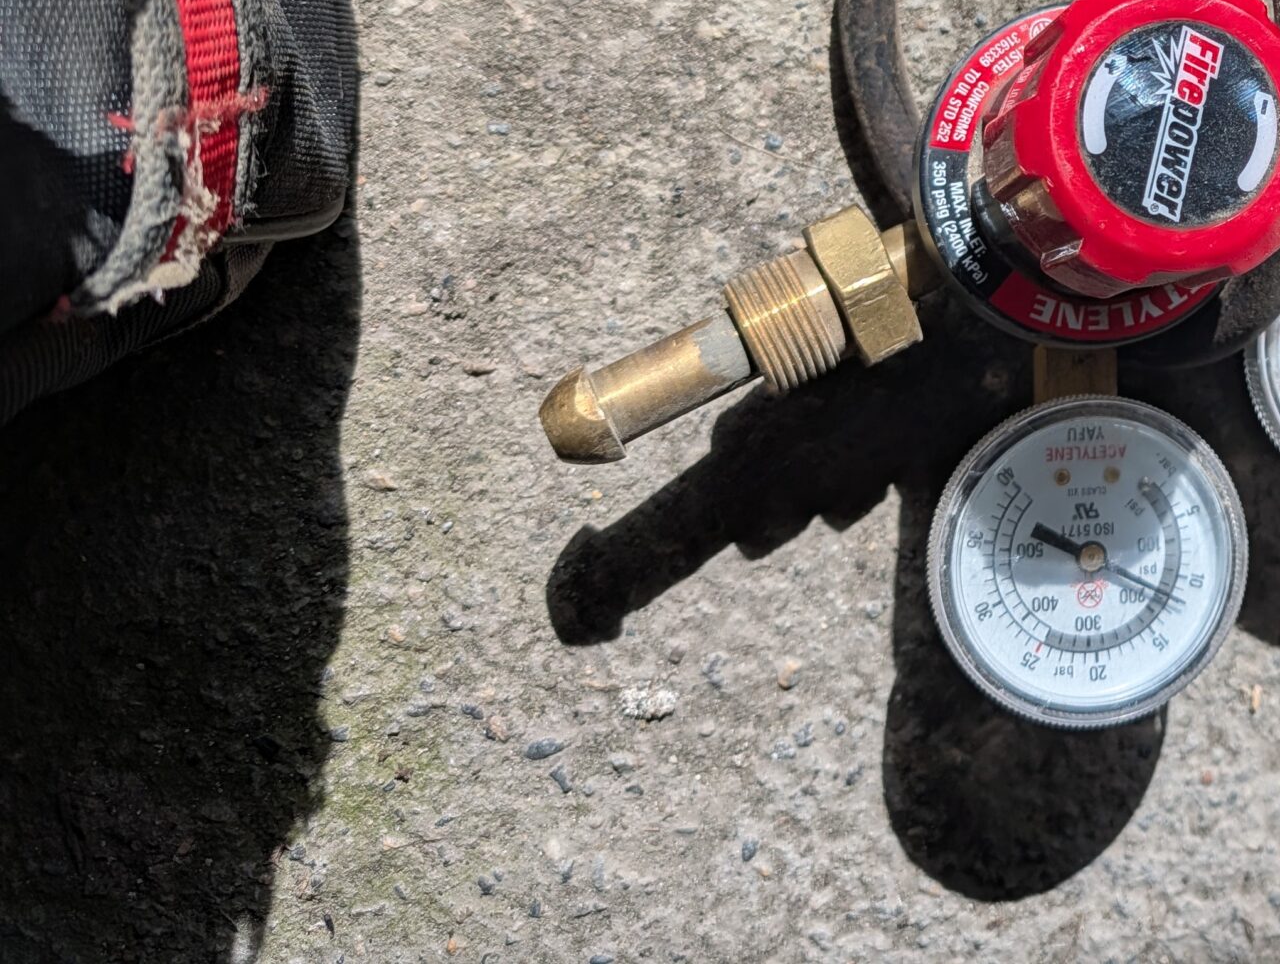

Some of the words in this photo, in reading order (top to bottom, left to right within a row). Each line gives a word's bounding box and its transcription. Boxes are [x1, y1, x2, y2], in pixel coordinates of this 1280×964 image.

[977, 31, 1021, 68] 3163339
[962, 68, 981, 85] TO
[953, 81, 971, 99] UL
[942, 96, 961, 121] STD
[953, 80, 990, 142] CONFORMS
[933, 121, 952, 143] 252
[1152, 33, 1221, 217] Firepower
[932, 161, 946, 186] 350
[931, 189, 949, 218] psig
[949, 181, 967, 217] MAX.
[958, 217, 985, 257] INLET:
[940, 220, 968, 257] (2400
[961, 255, 988, 285] kPa)
[1028, 282, 1200, 331] TYLENE
[1066, 426, 1105, 441] YAFU
[1045, 445, 1127, 462] ACETYLENE
[996, 467, 1016, 487] 40
[1126, 498, 1145, 518] psi
[1186, 504, 1201, 516] 5
[1059, 524, 1090, 537] 5171
[1094, 522, 1115, 536] ISO
[965, 530, 984, 549] 35
[1137, 537, 1162, 553] 100
[1016, 543, 1044, 559] 500
[1139, 562, 1157, 576] psi
[1188, 573, 1205, 588] 10
[1031, 596, 1059, 612] 400
[1119, 588, 1146, 604] 200
[973, 603, 994, 622] 30
[1074, 615, 1102, 632] 300
[1152, 633, 1171, 653] 15
[1020, 650, 1040, 671] 25
[1053, 665, 1074, 679] bar
[1089, 665, 1108, 681] 20
